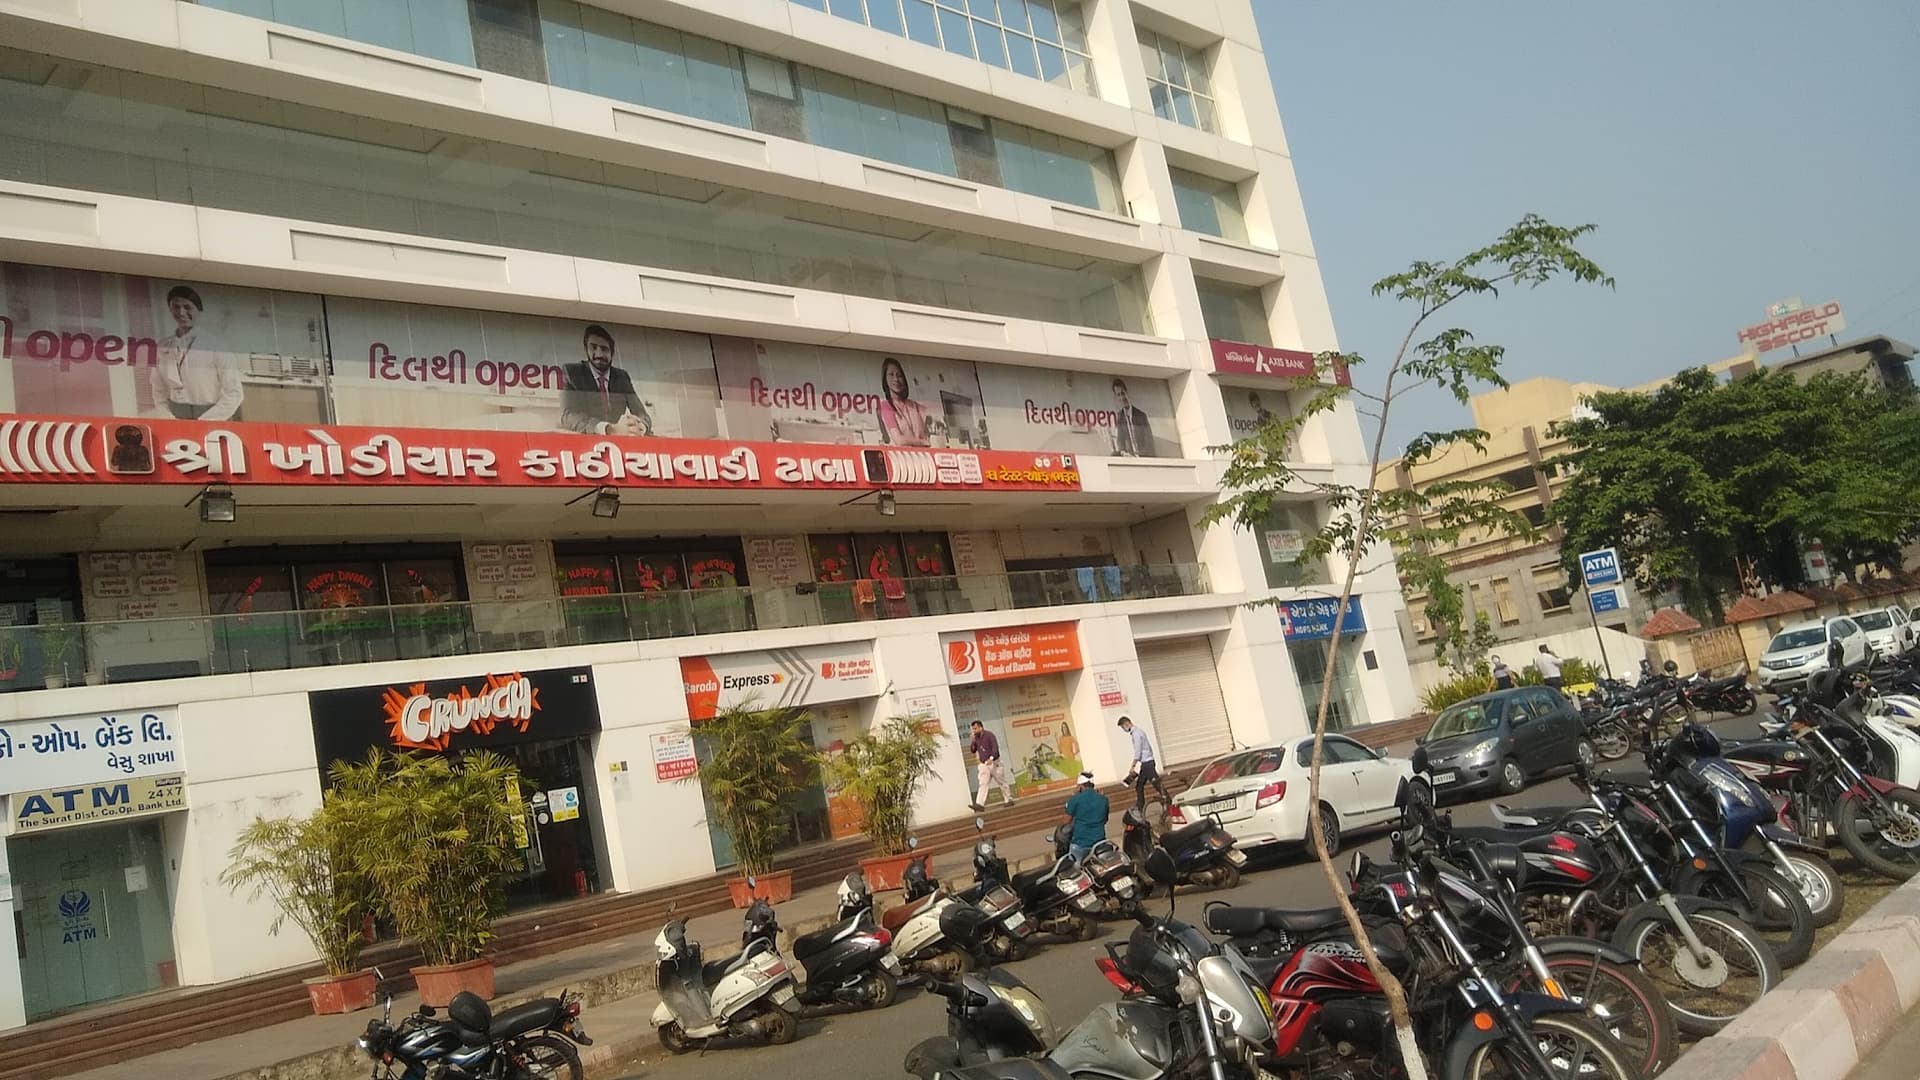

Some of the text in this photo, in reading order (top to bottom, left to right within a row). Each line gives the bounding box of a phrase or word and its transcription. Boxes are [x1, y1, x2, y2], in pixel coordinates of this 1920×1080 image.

[26, 328, 157, 372] open
[1268, 357, 1305, 370] AXIS BANK
[368, 342, 566, 394] દિલથી open
[750, 377, 881, 419] દિલથી open
[1024, 398, 1117, 431] દિલથી open
[161, 429, 246, 475] શ્રી
[263, 428, 497, 478] ખોડીયાર
[519, 441, 760, 482] કાઠીયાવાડી
[568, 568, 600, 580] HAPPY
[1585, 555, 1613, 572] ATM
[306, 572, 334, 592] HAPPY
[838, 669, 850, 677] Bank
[988, 664, 1005, 676] Bank
[1005, 662, 1013, 673] of
[1013, 660, 1037, 673] Baroda
[723, 674, 770, 691] Express
[401, 677, 532, 743] CRUNCH
[32, 723, 87, 754] ઓપ.
[96, 717, 134, 749] બેંક
[141, 714, 172, 744] લિ.
[107, 750, 175, 774] વેસુ શાખા
[18, 783, 130, 818] ATM
[19, 819, 40, 828] The
[42, 813, 72, 826] Surat
[75, 809, 98, 821] Dist.
[138, 801, 164, 811] Bank
[166, 798, 184, 809] Ltd.
[63, 927, 96, 944] ATM
